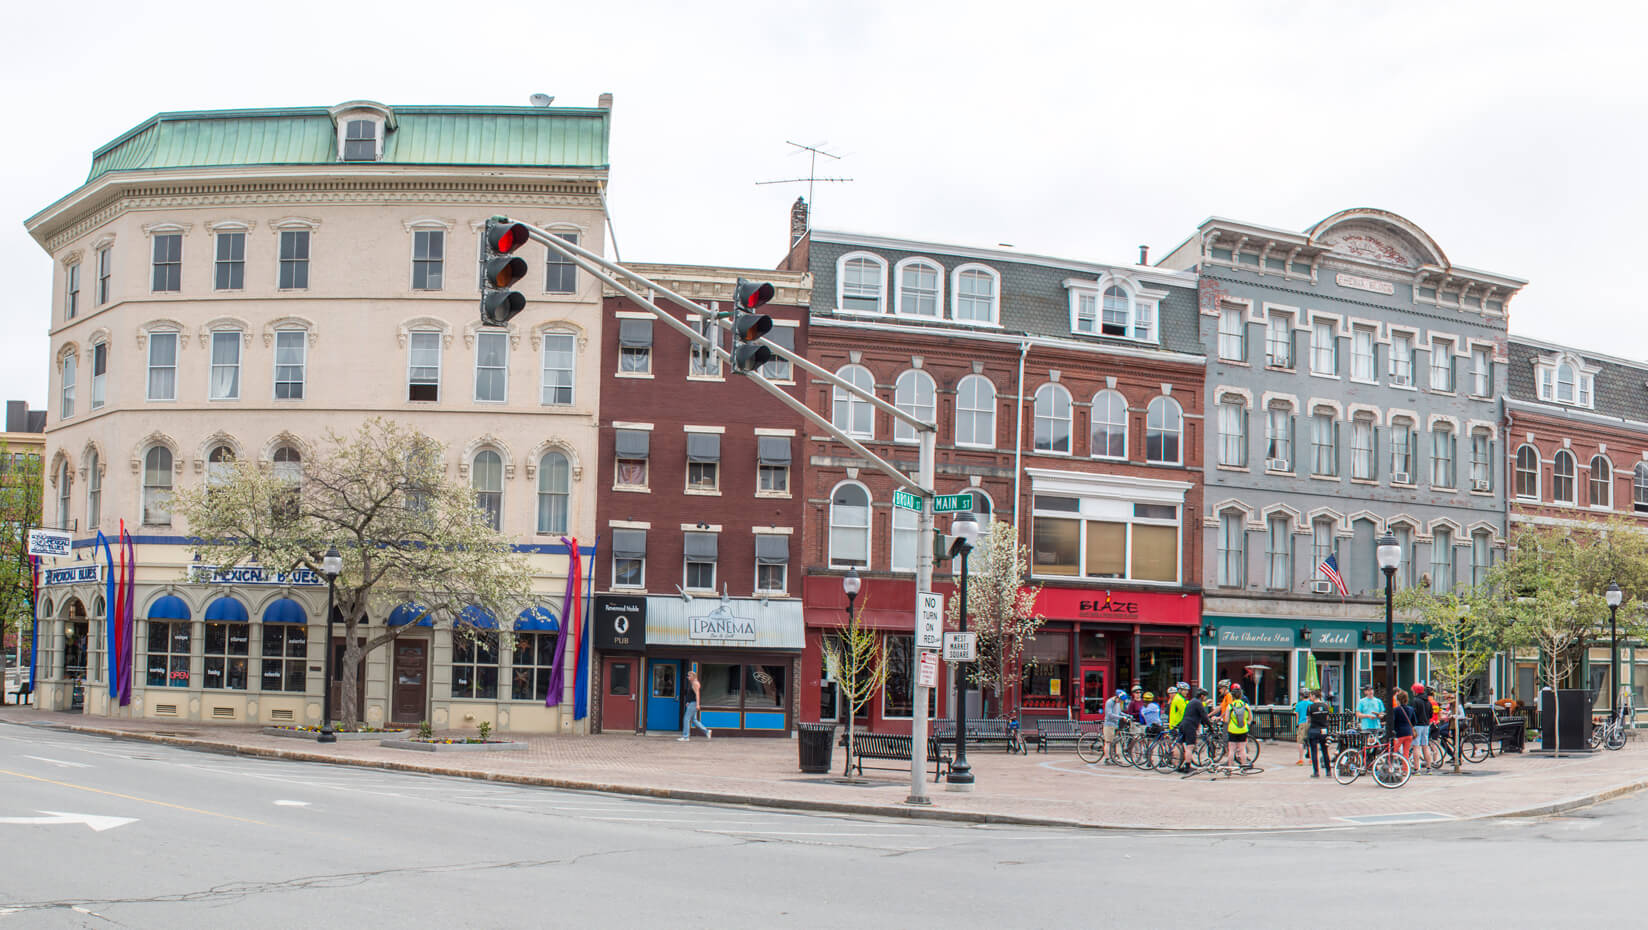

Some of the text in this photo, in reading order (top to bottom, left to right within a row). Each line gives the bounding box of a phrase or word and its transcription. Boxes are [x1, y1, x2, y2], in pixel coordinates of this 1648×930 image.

[896, 492, 914, 509] BROAD
[935, 496, 970, 510] MAIN ST
[79, 567, 97, 580] BLUES
[277, 570, 319, 584] BUES
[924, 597, 936, 609] NO
[1080, 600, 1139, 613] BLAZE
[923, 610, 938, 621] TURN
[694, 619, 754, 634] IPANEMA
[925, 623, 934, 632] ON
[923, 634, 935, 644] RED
[953, 634, 966, 642] WEST
[1222, 631, 1290, 642] The Charles Inn
[1318, 632, 1351, 643] Hotel
[950, 642, 969, 650] MARKET
[949, 650, 969, 658] SQUARE
[170, 671, 189, 680] OPEN
